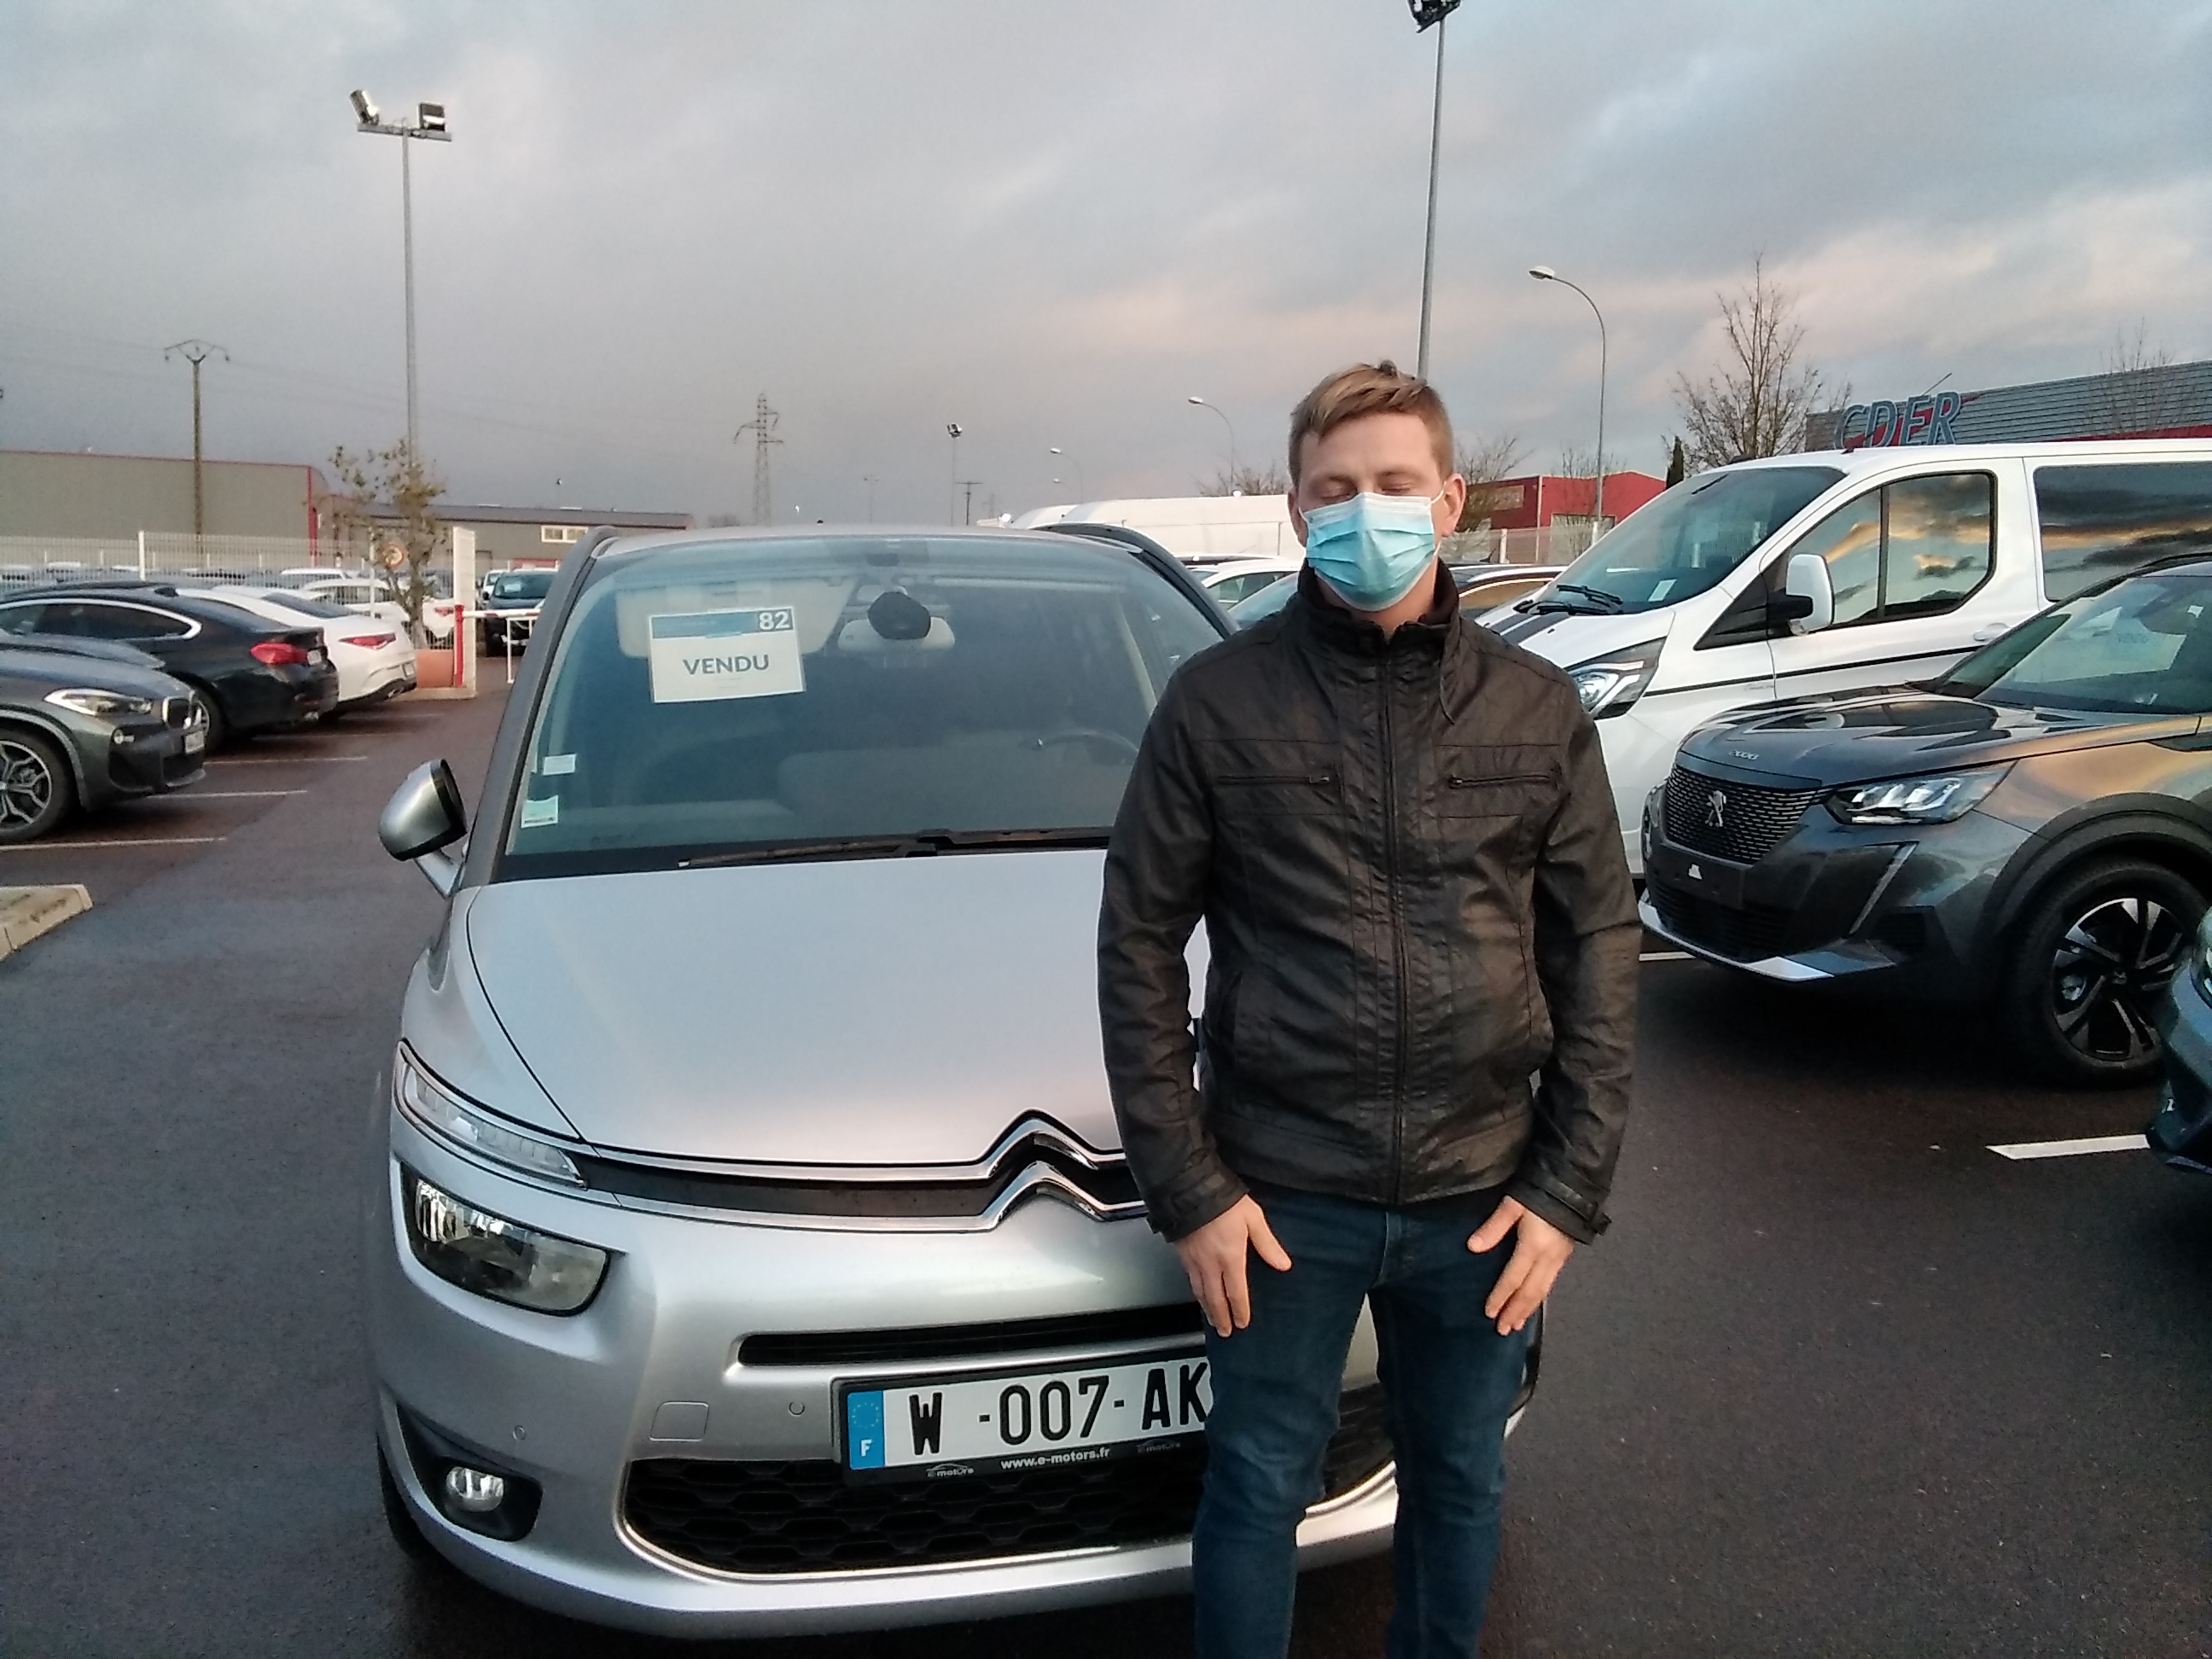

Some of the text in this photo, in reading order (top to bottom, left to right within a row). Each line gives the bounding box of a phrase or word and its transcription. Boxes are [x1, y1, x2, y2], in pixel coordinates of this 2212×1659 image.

[1834, 392, 1961, 448] CDER
[759, 611, 790, 630] 82
[683, 654, 770, 675] VENDU
[861, 1440, 872, 1457] F
[1000, 1447, 1110, 1470] www.e-motors.fr
